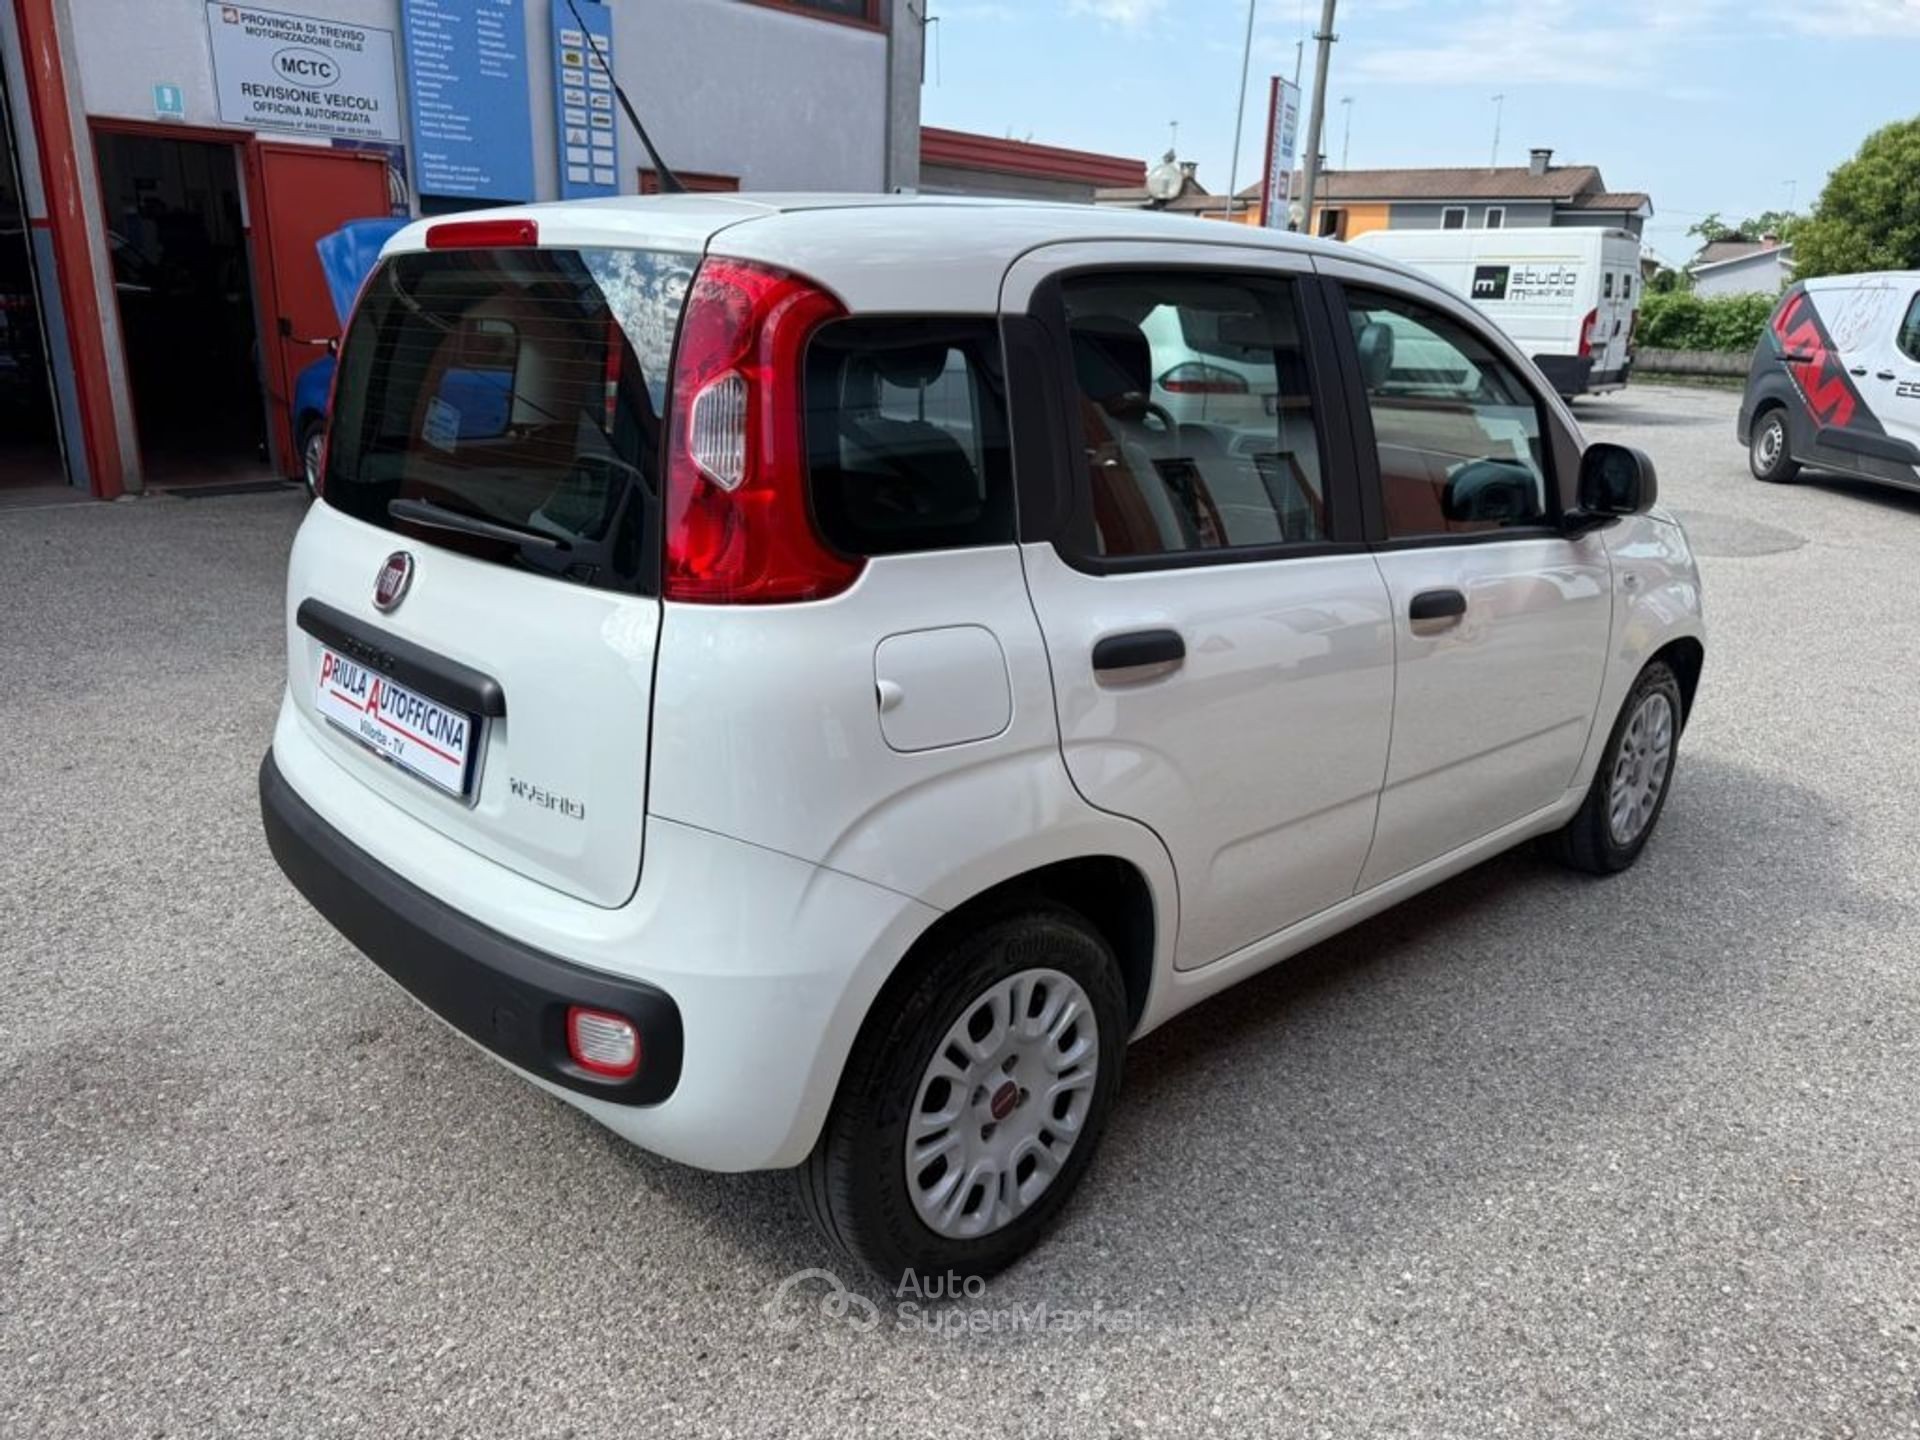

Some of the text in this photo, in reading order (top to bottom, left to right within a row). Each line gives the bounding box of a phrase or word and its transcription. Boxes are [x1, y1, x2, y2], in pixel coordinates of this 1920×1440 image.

[240, 13, 366, 42] PROVINCIA DI TREVISO
[245, 26, 363, 52] MOTORIZZAZIONE CIVILE
[280, 57, 332, 78] MCTC
[240, 82, 379, 112] REVISIONE VEICOLI
[252, 100, 371, 124] OFFICINA AUTORIZZATA
[1511, 265, 1577, 285] studio
[320, 652, 367, 700] PRIULA
[365, 679, 465, 752] AUTOFFICINA
[359, 718, 388, 746] Villorba
[393, 737, 405, 755] TV
